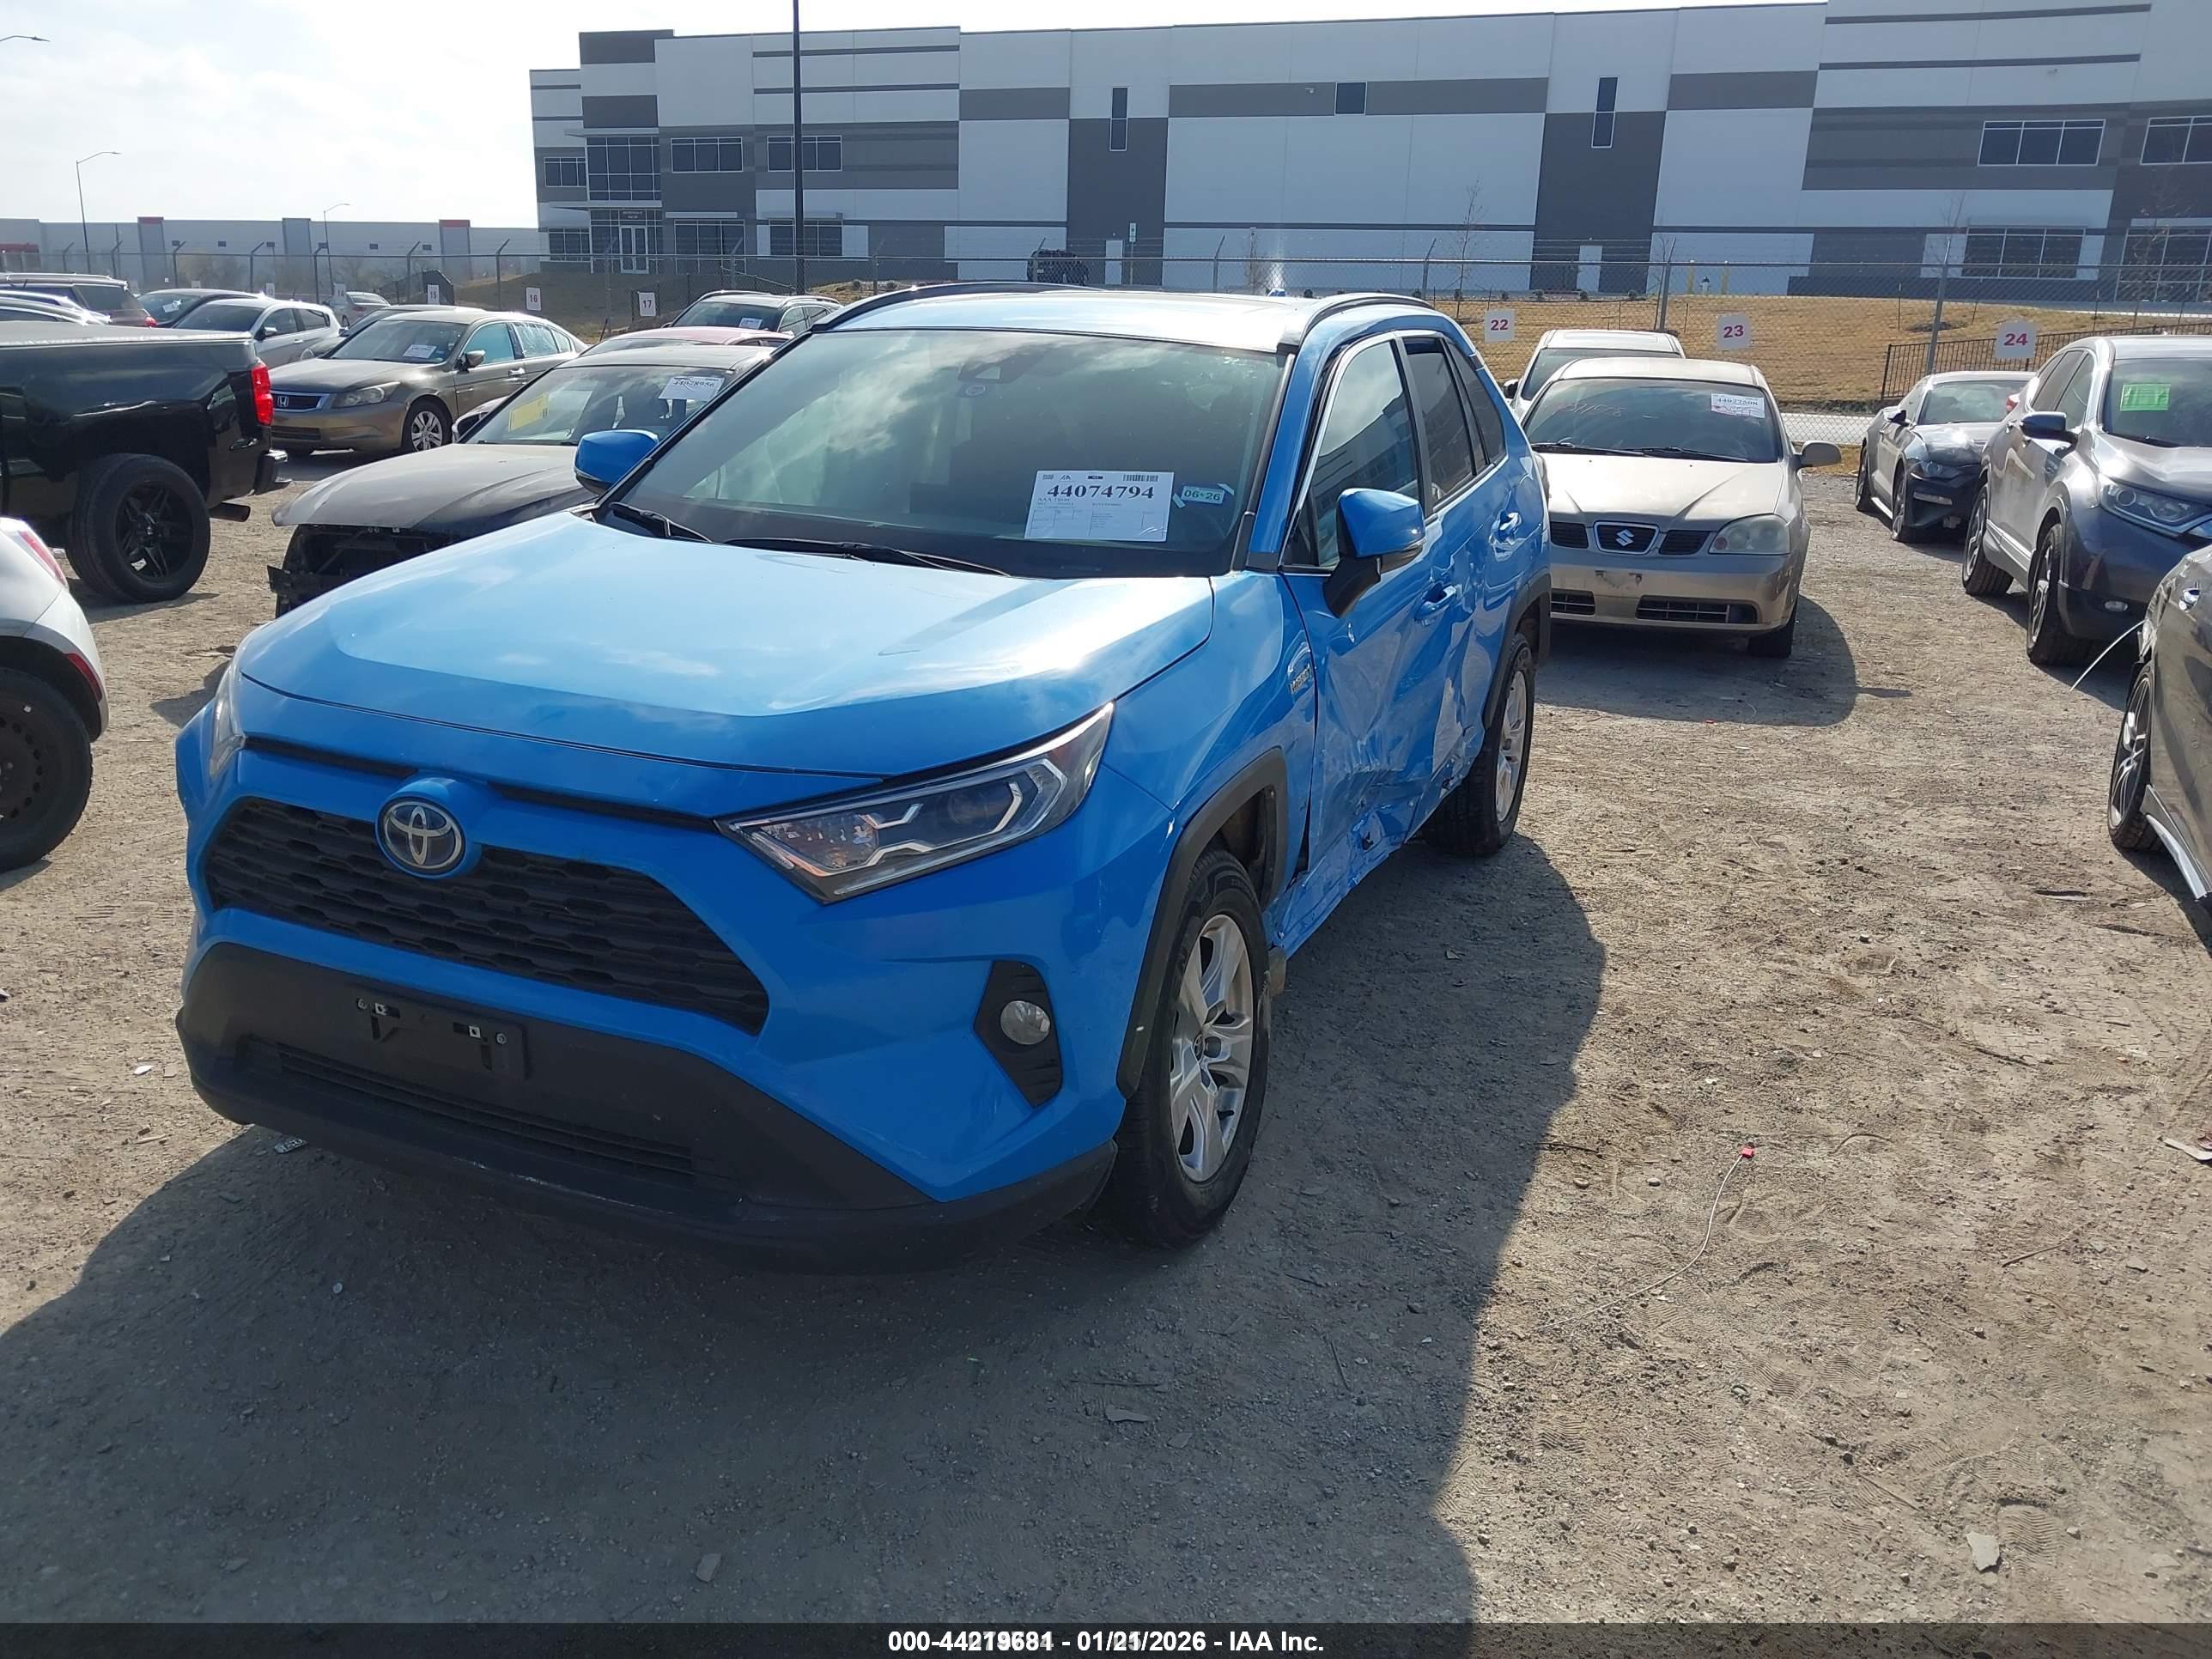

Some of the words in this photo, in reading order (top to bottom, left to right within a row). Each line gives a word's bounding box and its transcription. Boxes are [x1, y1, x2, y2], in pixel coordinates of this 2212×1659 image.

[429, 291, 437, 300] 15
[529, 295, 538, 303] 16
[642, 300, 653, 308] 17
[1490, 319, 1510, 331] 22
[1723, 325, 1744, 338] 23
[2003, 333, 2029, 346] 24
[1047, 484, 1154, 499] 44074794
